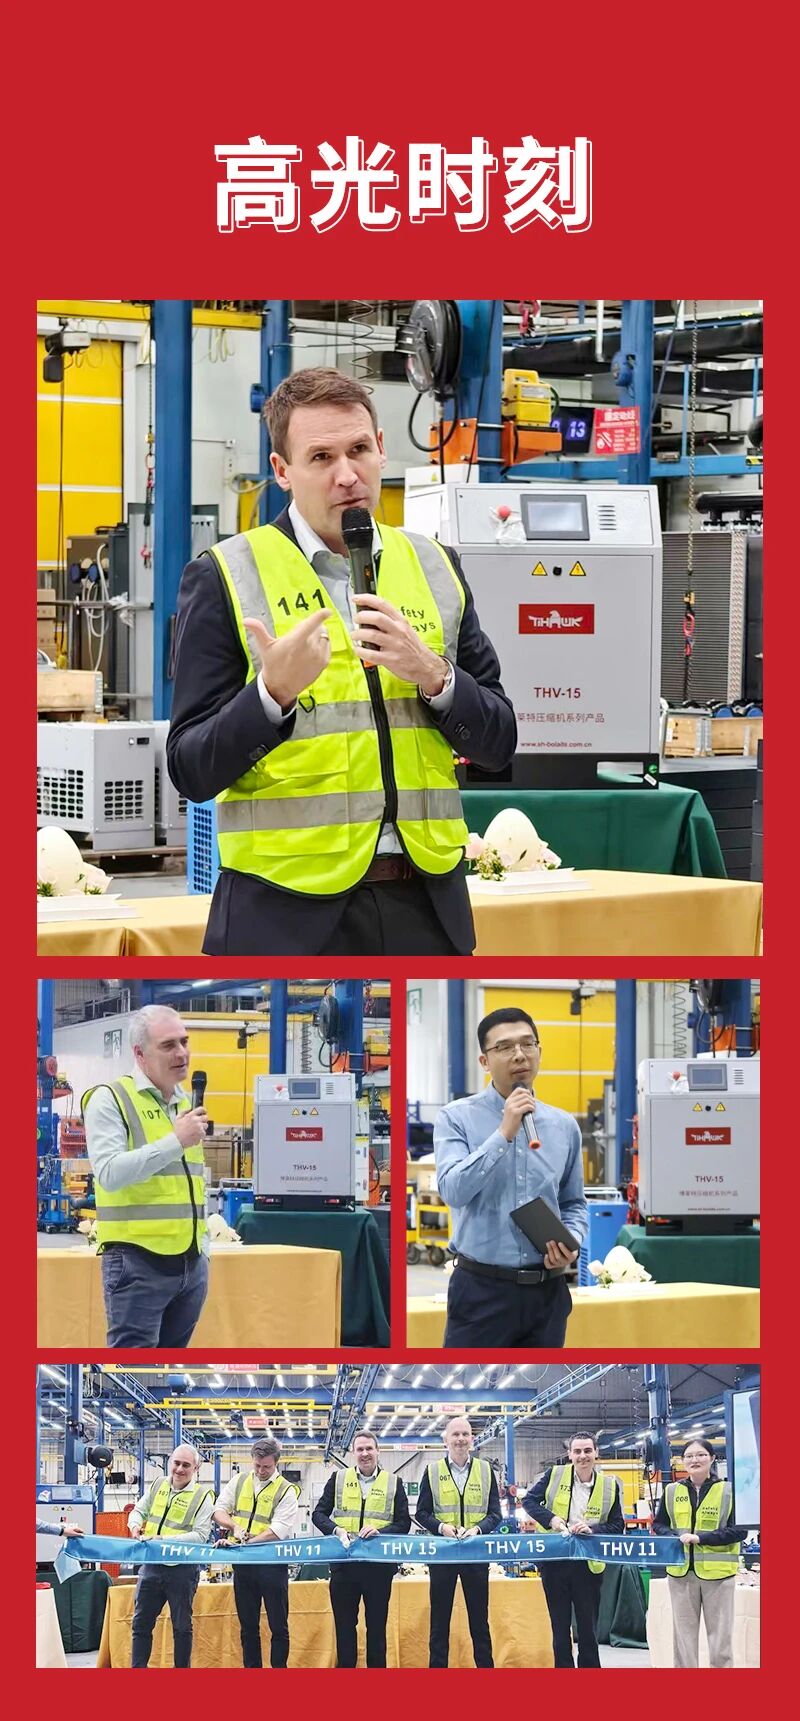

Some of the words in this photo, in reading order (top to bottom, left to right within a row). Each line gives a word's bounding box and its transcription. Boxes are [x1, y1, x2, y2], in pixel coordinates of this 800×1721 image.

[568, 420, 586, 438] 13
[277, 588, 326, 616] 141
[400, 606, 425, 619] fety
[533, 687, 581, 699] THV-15
[517, 712, 605, 723] 莱特压缩机系列产品
[141, 1109, 160, 1120] 107
[695, 1175, 724, 1183] THV-15
[160, 1544, 196, 1557] THV
[274, 1544, 302, 1557] THV
[306, 1544, 321, 1556] 11
[380, 1542, 414, 1555] THV
[418, 1542, 437, 1555] 15
[485, 1540, 521, 1554] THV
[526, 1540, 546, 1553] 15
[600, 1542, 634, 1556] THV
[638, 1542, 657, 1556] 11
